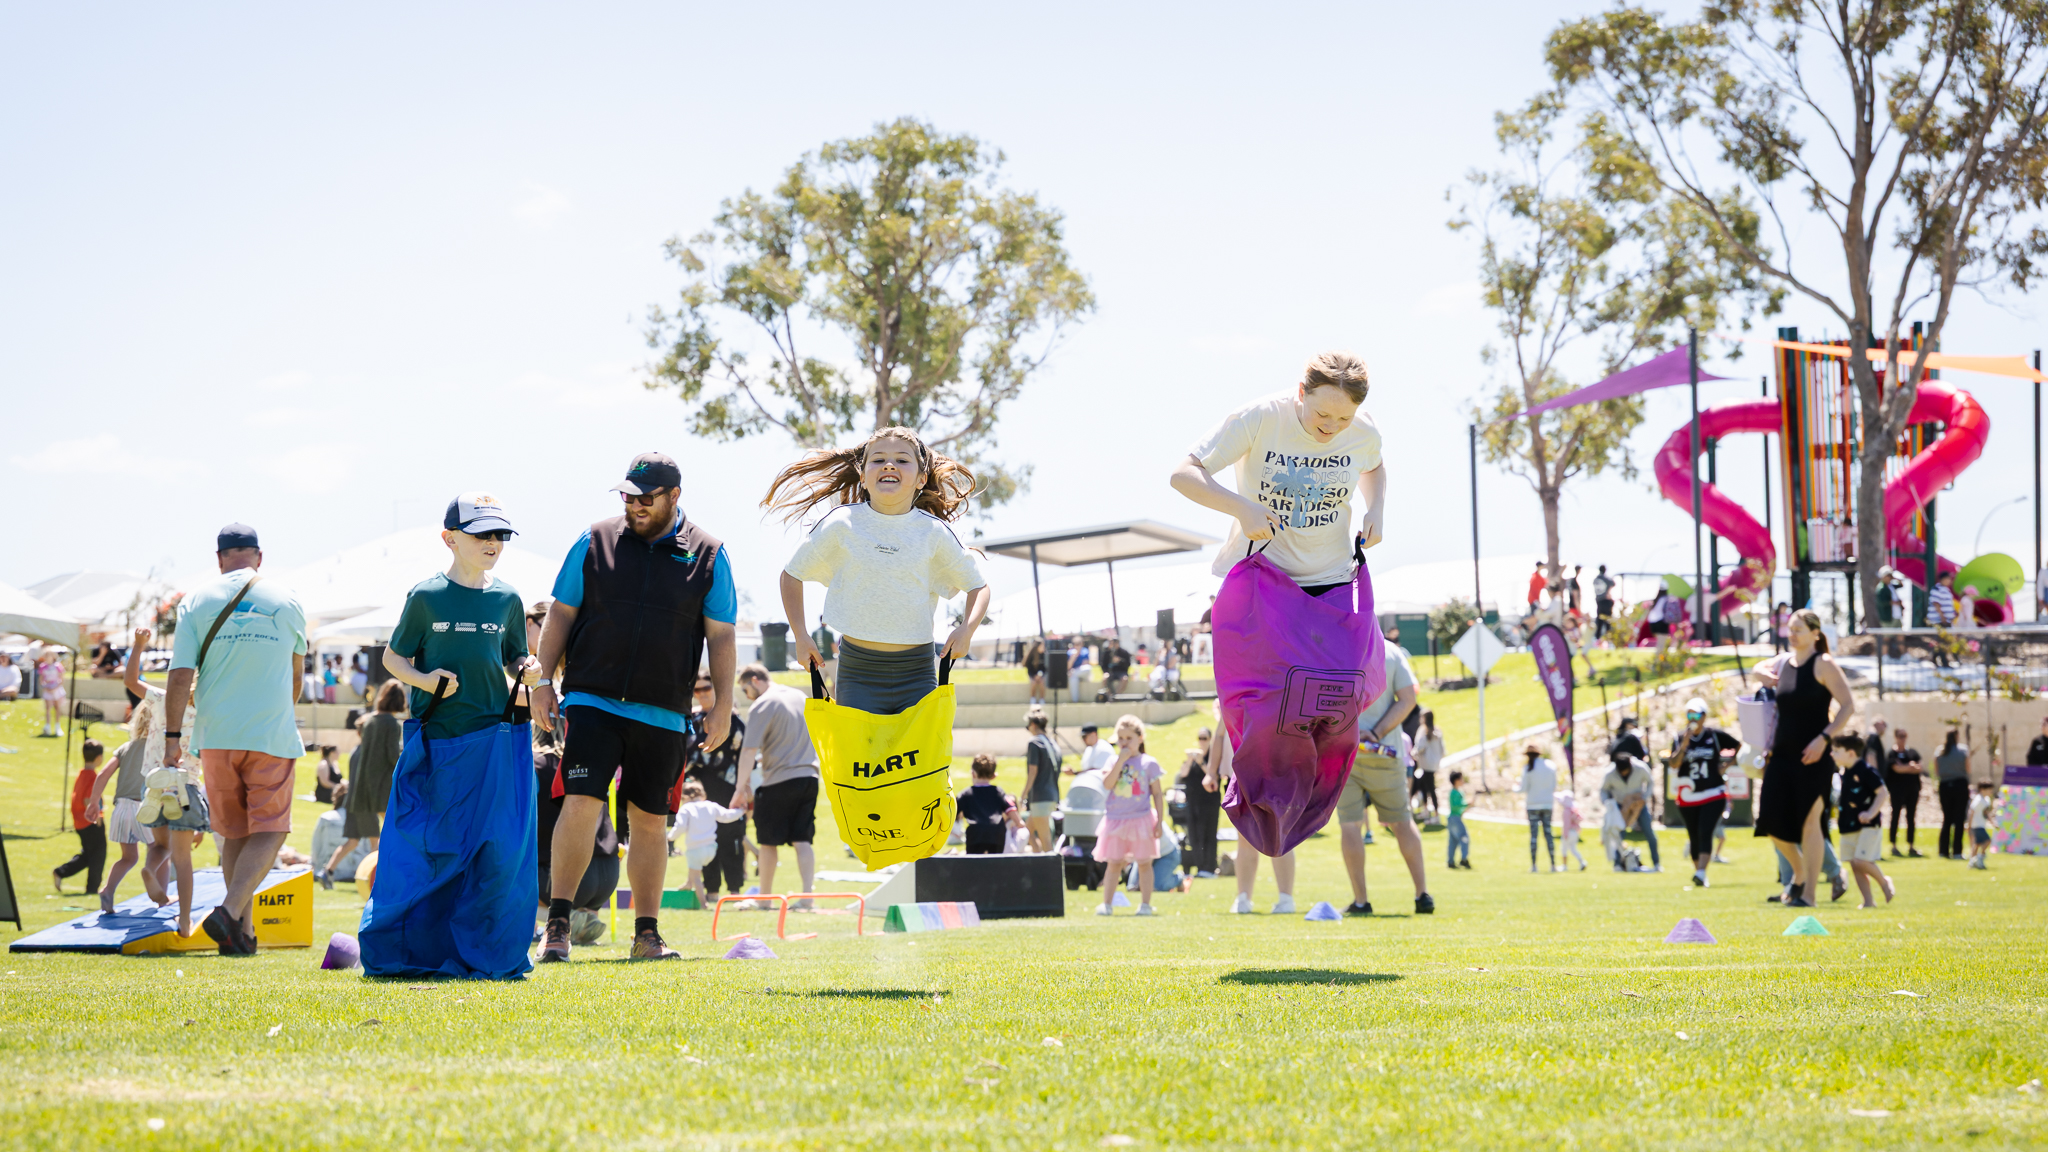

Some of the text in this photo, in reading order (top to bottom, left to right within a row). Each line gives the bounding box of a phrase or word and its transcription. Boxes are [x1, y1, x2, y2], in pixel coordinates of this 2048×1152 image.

[1265, 451, 1351, 468] PARADISO
[255, 633, 279, 641] ROCKS
[1320, 684, 1344, 692] FIVE
[853, 749, 920, 778] HART
[1690, 761, 1709, 779] 24
[857, 827, 905, 842] ONE
[259, 894, 294, 906] HART
